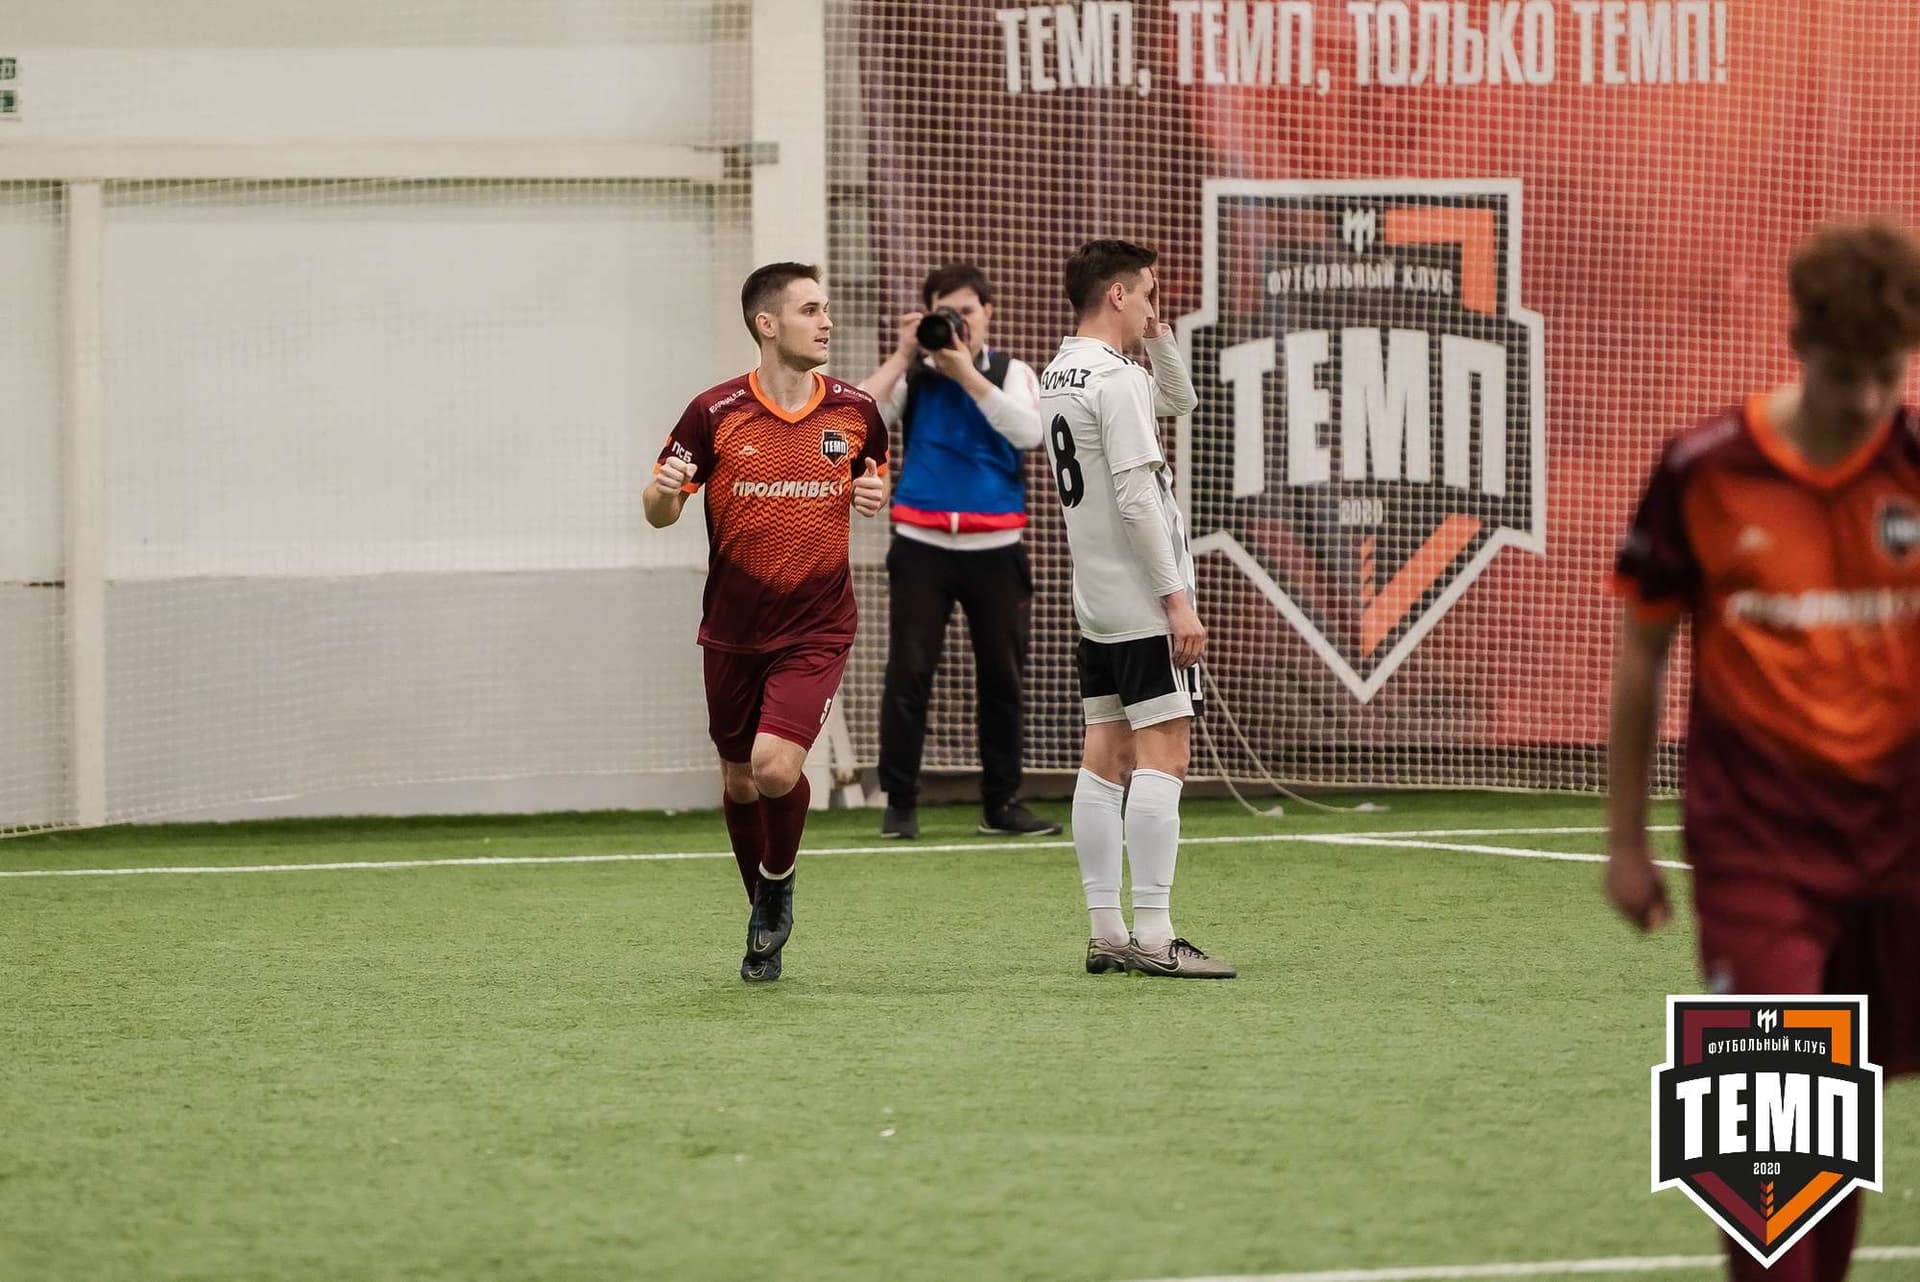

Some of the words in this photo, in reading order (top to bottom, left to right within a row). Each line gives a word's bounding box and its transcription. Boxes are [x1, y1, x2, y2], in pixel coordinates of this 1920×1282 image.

[996, 2, 1150, 96] ТЕМП,
[1169, 1, 1330, 96] ТЕМП,
[1346, 0, 1555, 86] ТОЛЬКО
[1573, 0, 1727, 85] ТЕМП!
[1402, 264, 1453, 295] КЛУБ
[1220, 326, 1506, 500] ТЕМП
[671, 440, 693, 463] ПСБ
[823, 440, 846, 454] ТЕМП
[1340, 499, 1383, 525] 2020
